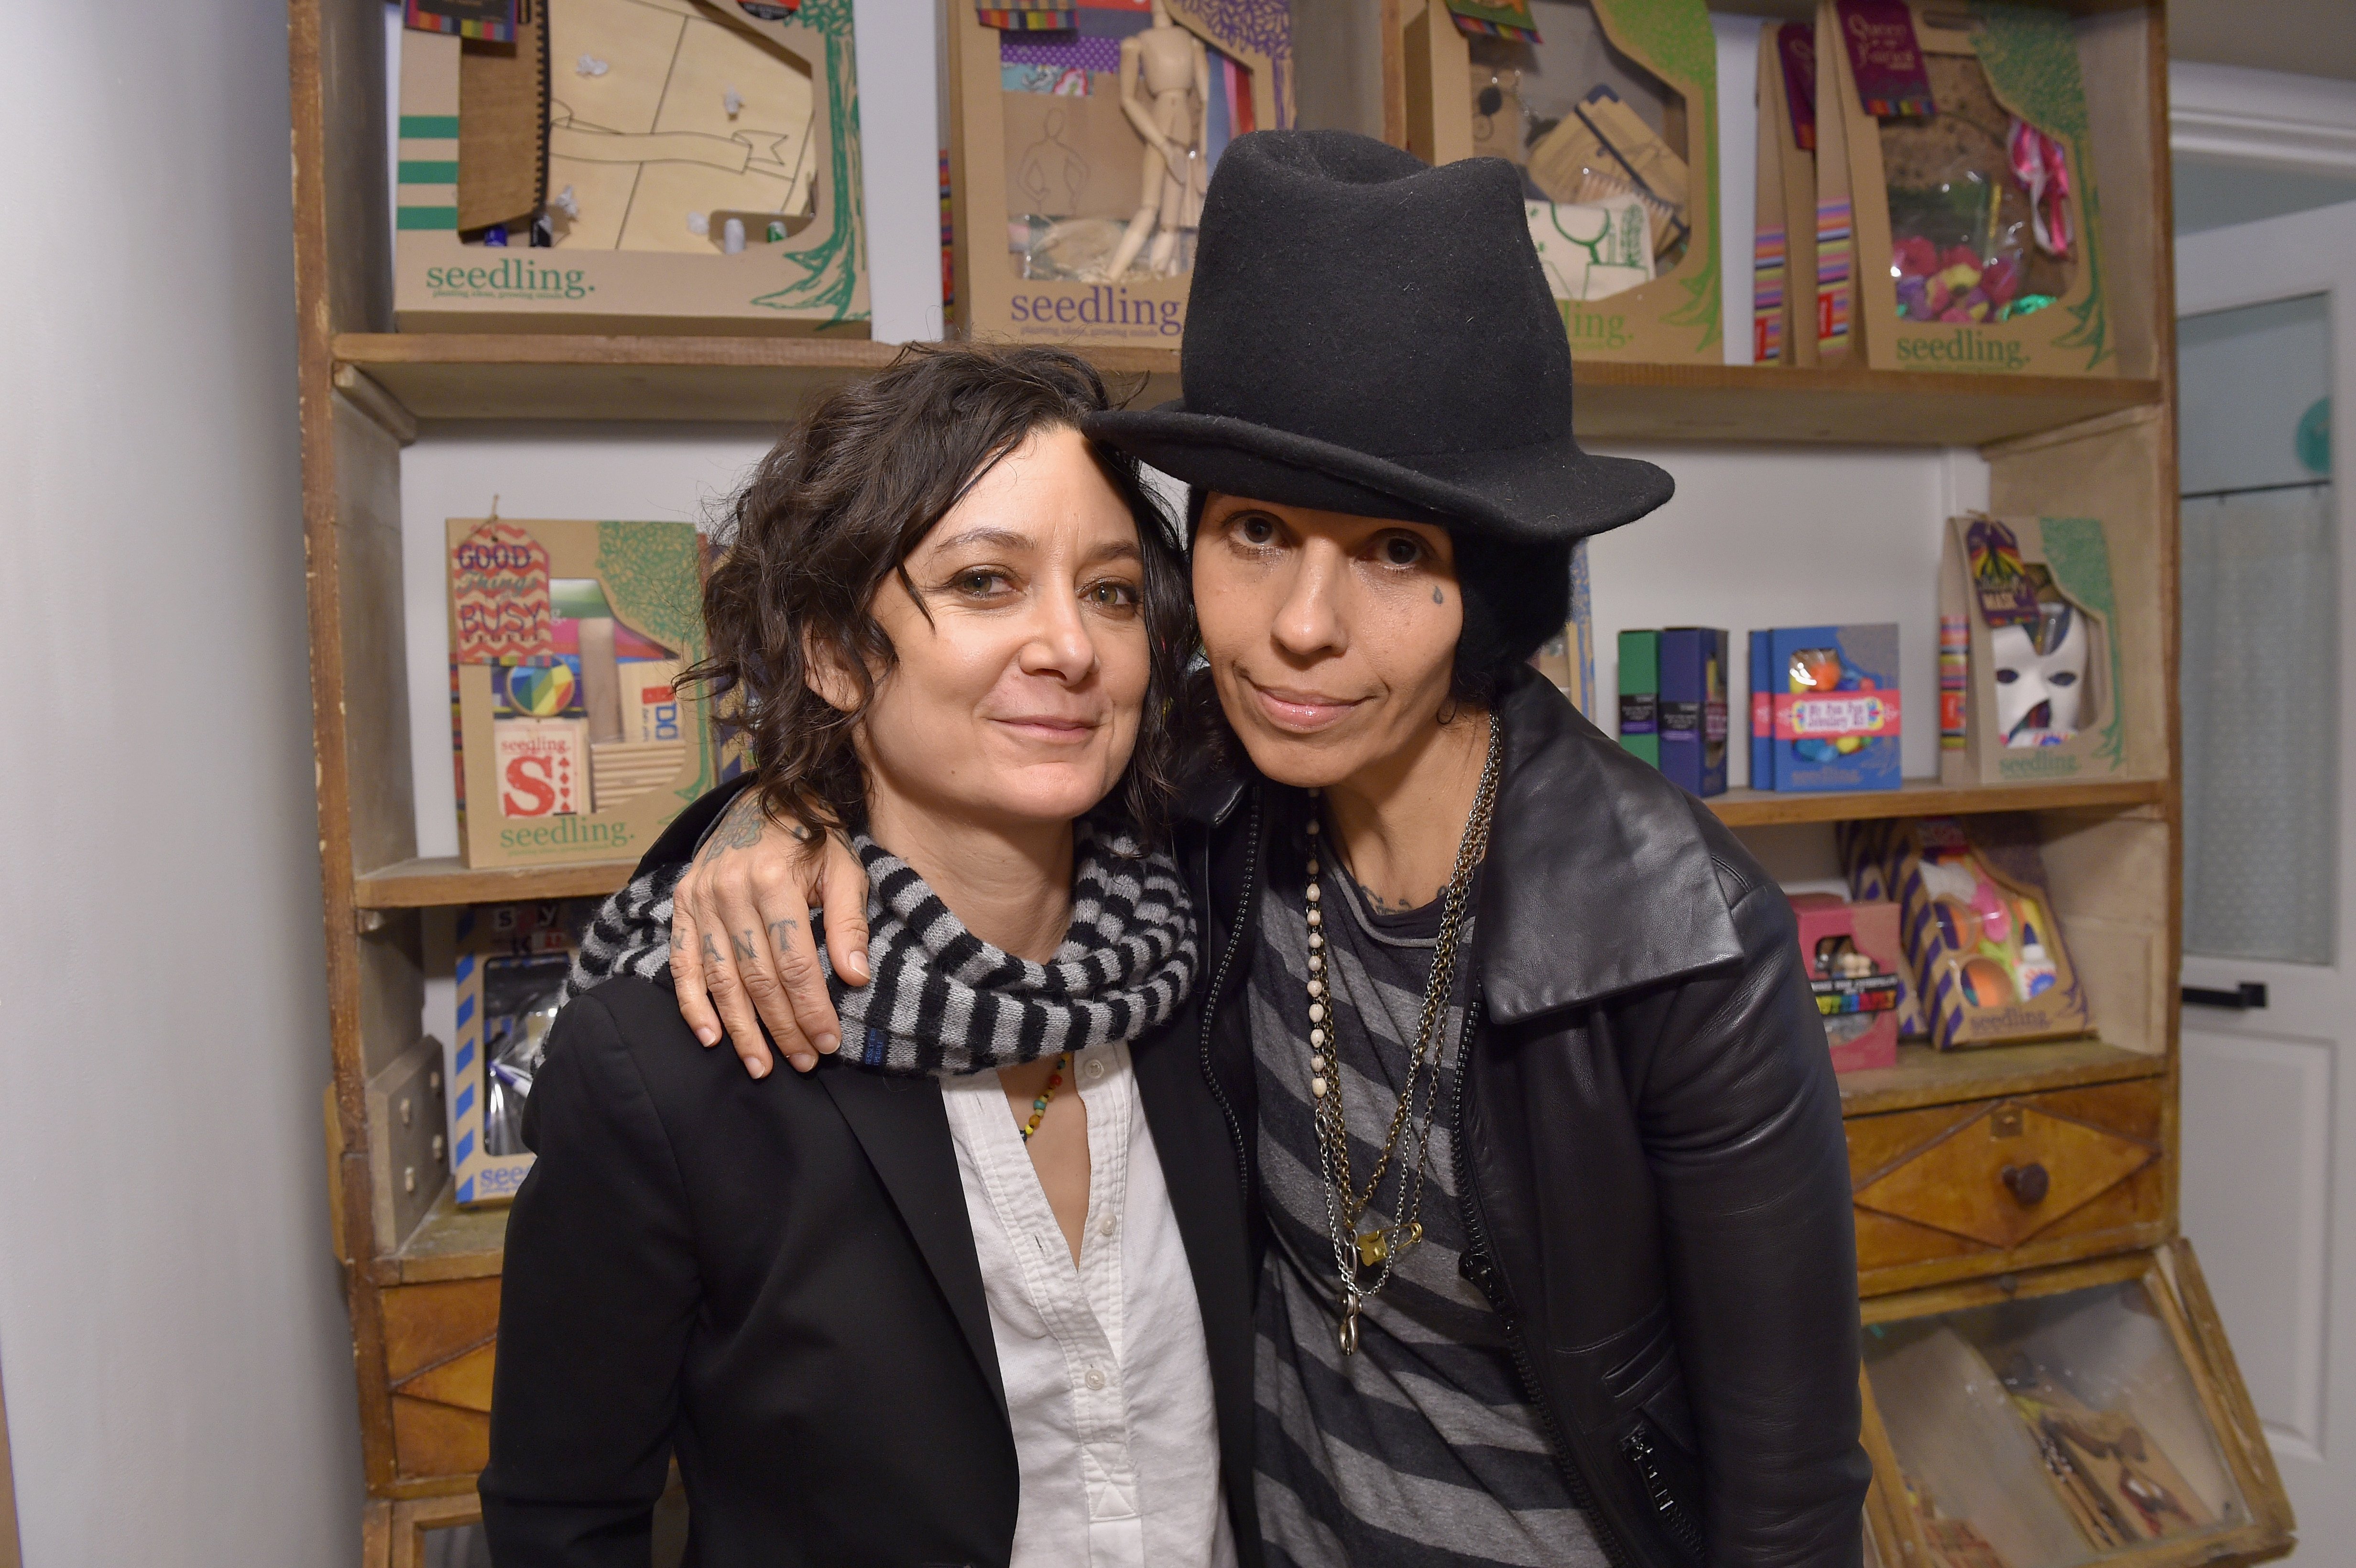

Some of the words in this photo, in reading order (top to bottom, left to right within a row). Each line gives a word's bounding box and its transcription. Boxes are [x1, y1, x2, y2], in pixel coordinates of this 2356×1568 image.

[458, 544, 531, 569] GOOD
[460, 598, 541, 641] BUSY
[500, 816, 635, 847] seedling.
